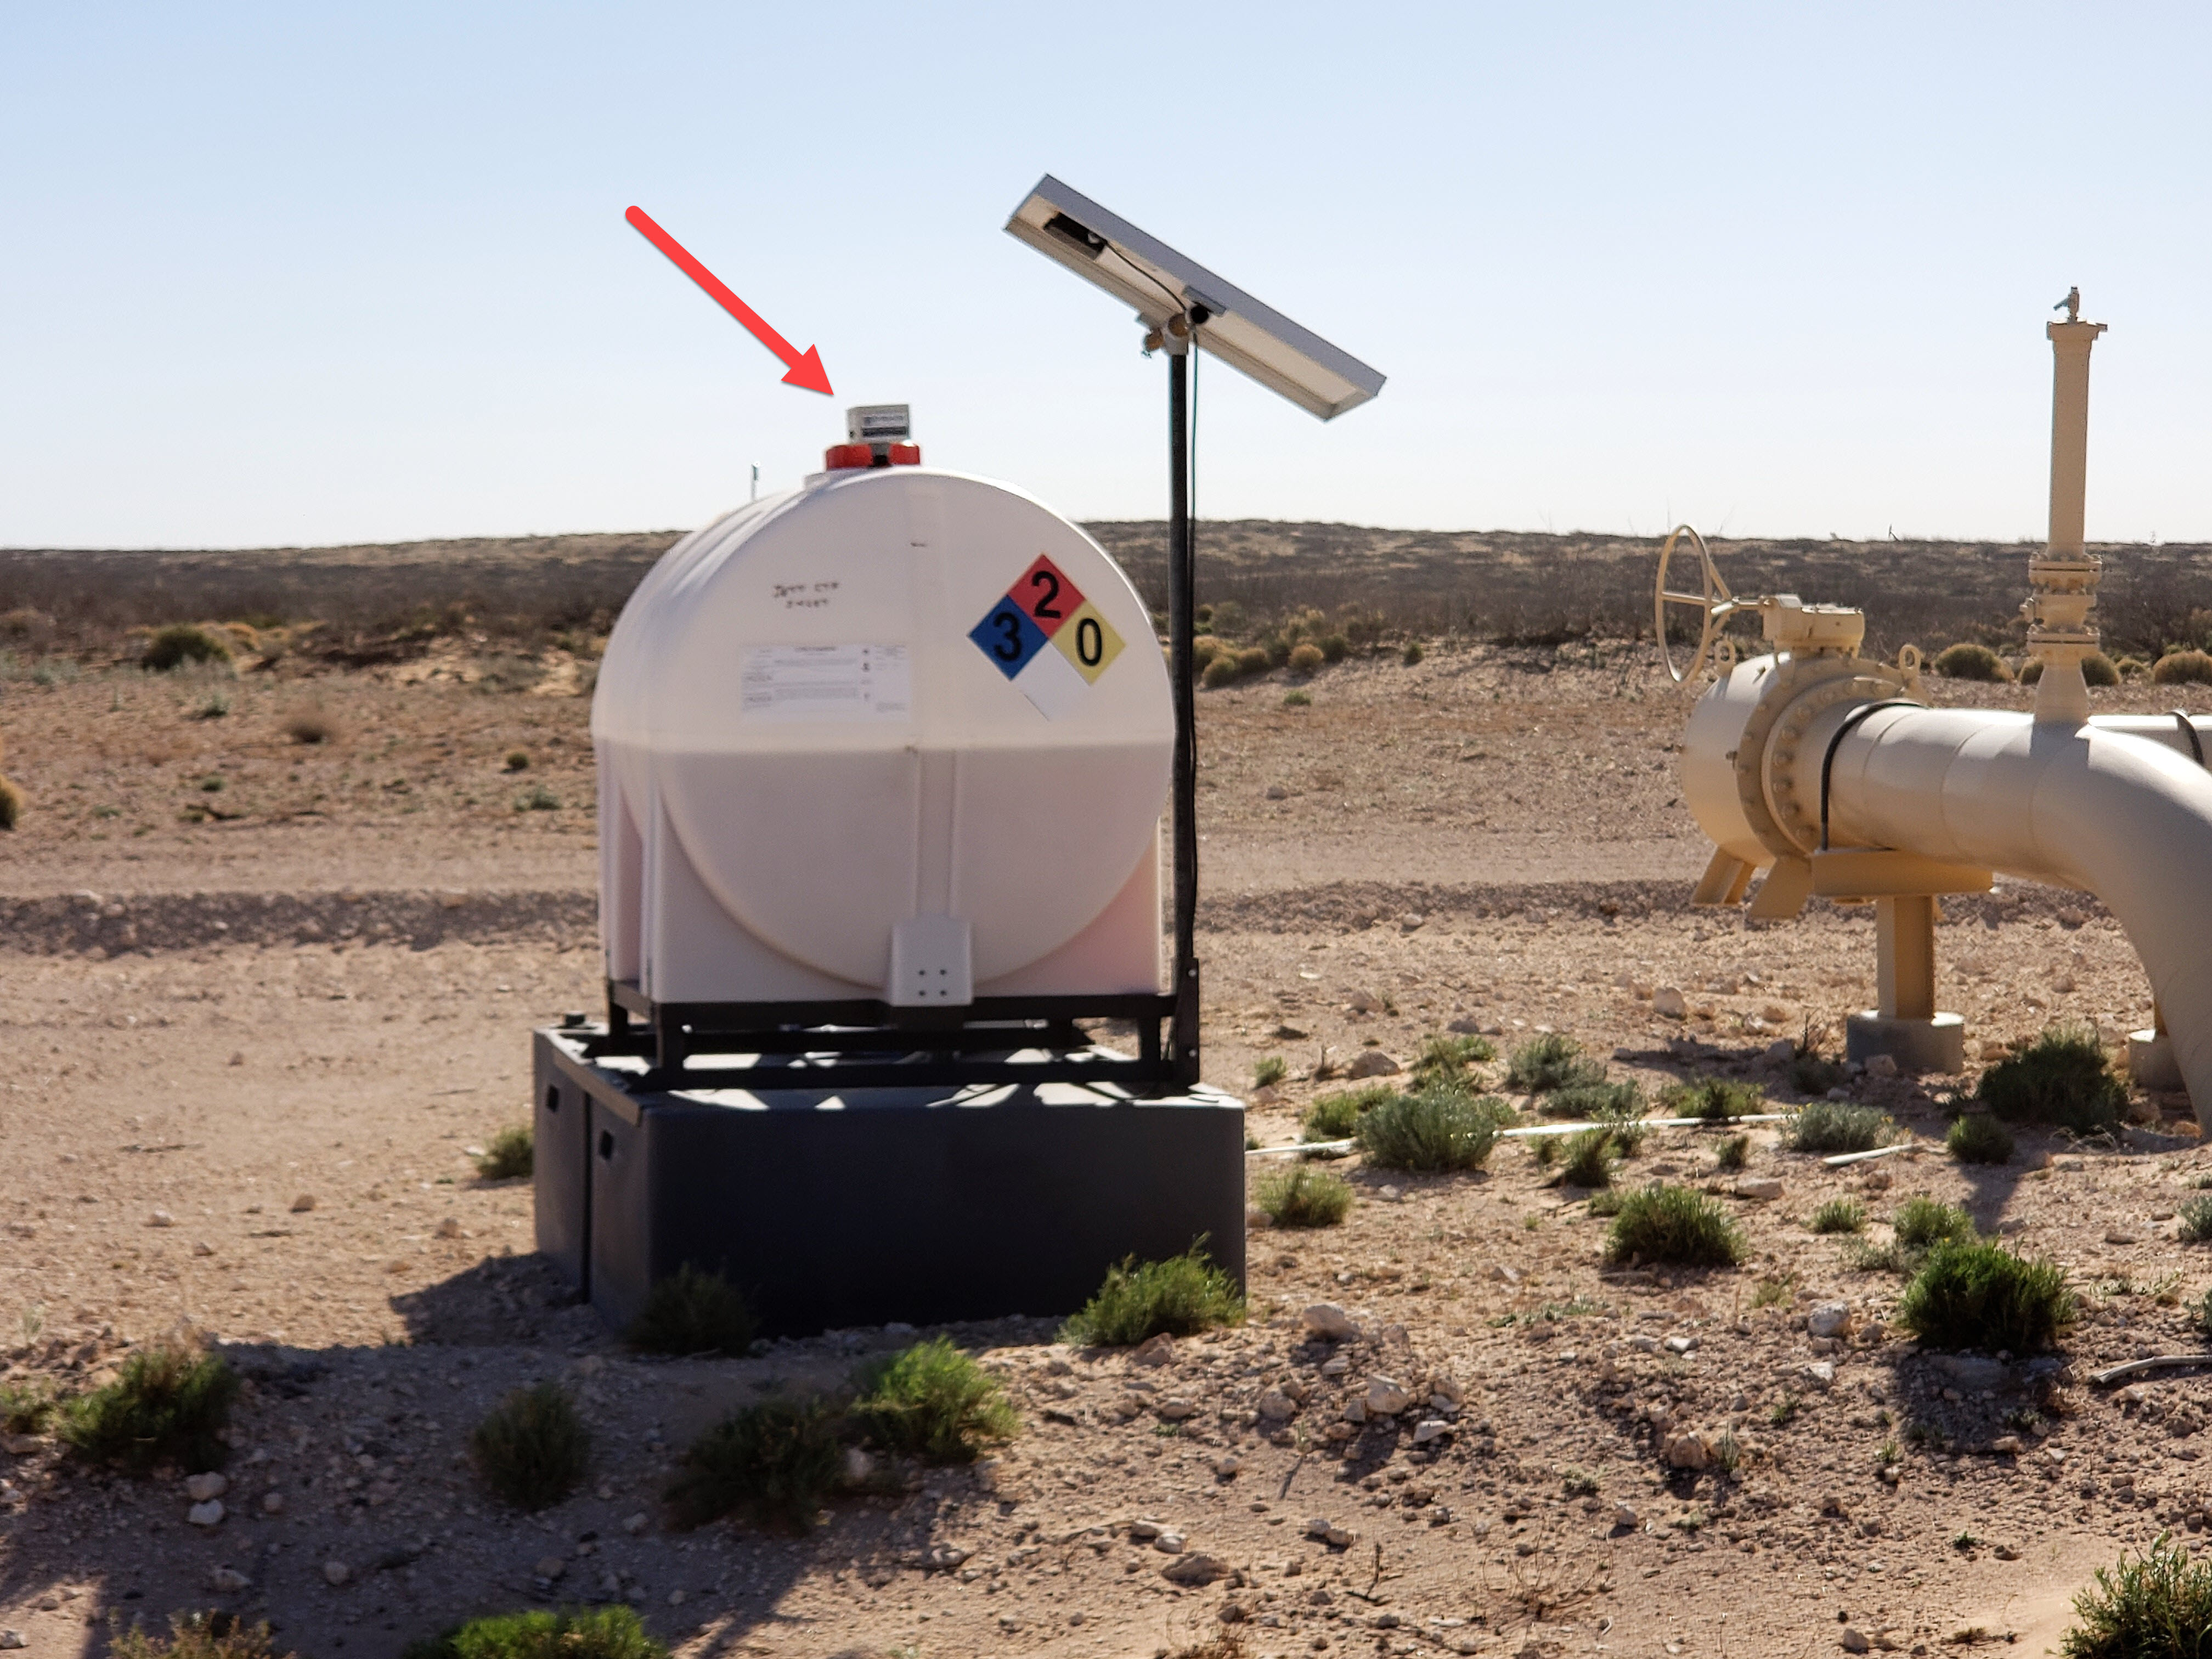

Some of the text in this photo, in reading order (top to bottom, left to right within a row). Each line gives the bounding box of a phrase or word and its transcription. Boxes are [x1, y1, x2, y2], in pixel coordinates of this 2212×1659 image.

[1032, 571, 1060, 618] 2
[995, 613, 1021, 660] 3
[1077, 618, 1102, 666] 0
